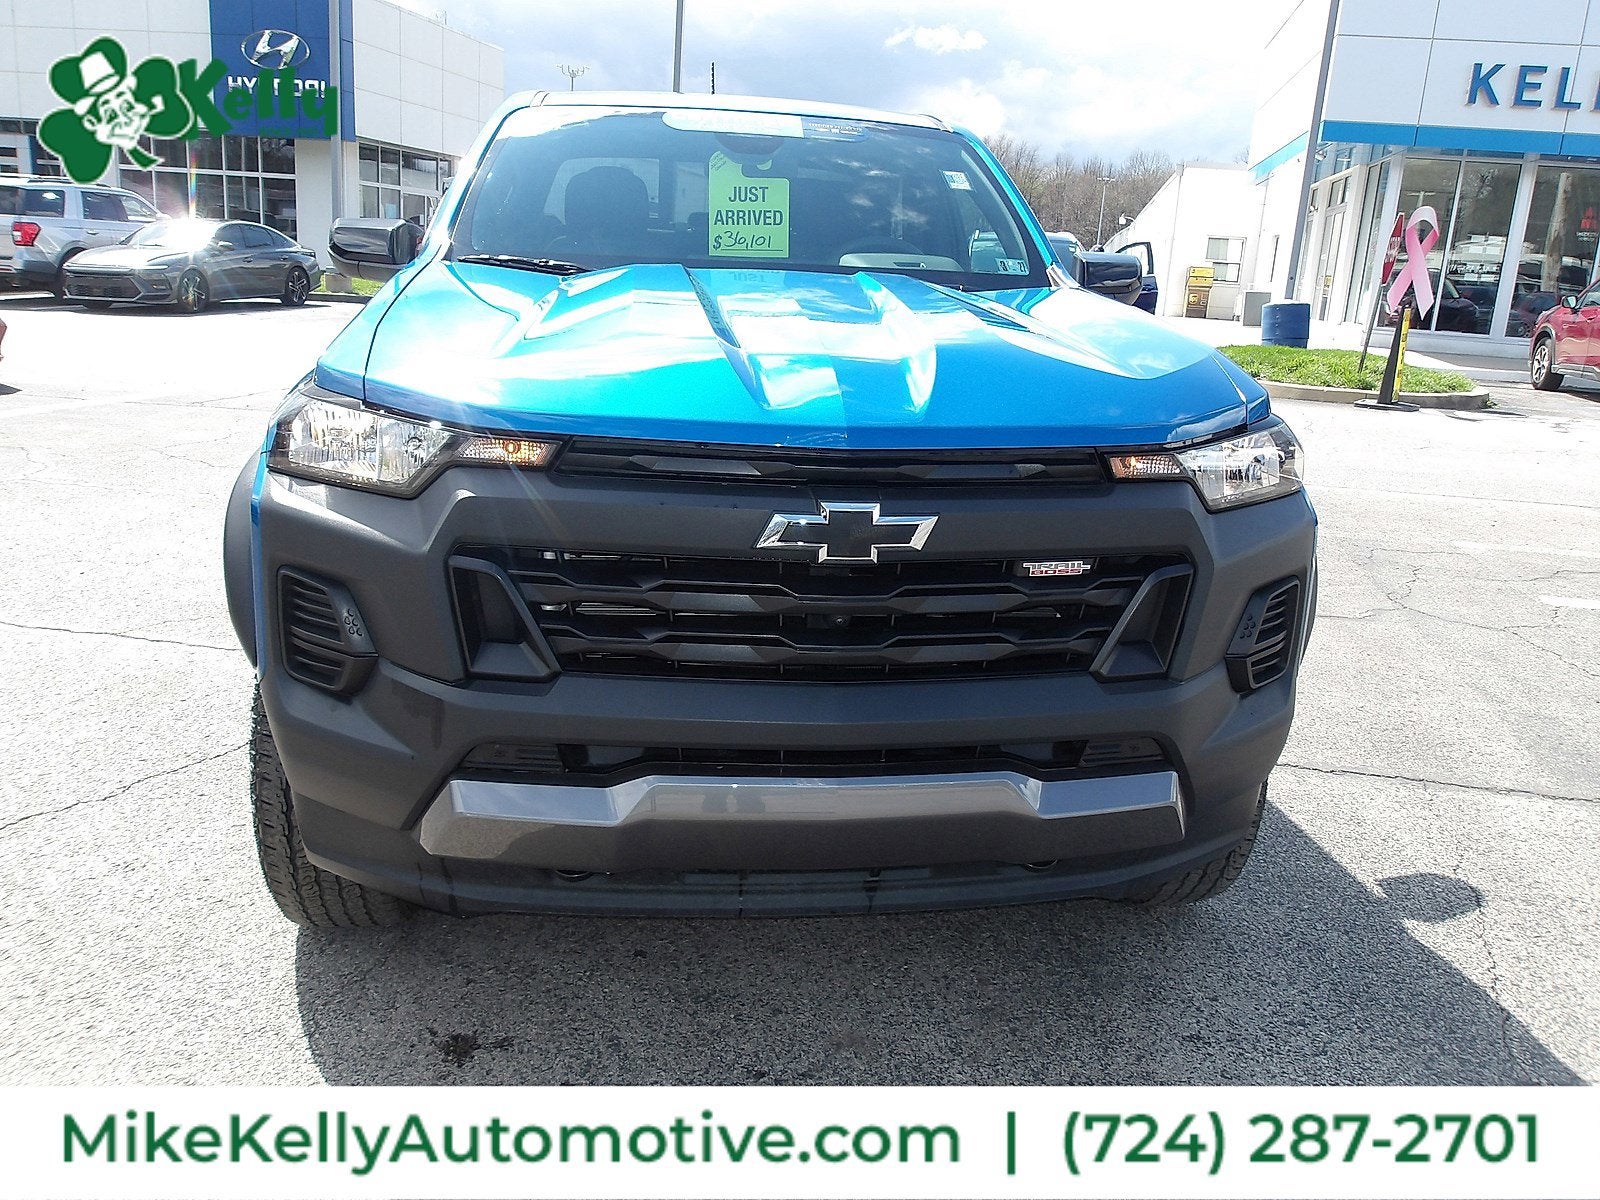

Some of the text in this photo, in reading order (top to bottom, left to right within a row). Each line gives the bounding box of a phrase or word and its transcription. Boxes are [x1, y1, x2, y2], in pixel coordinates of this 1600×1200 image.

[1465, 62, 1600, 111] KEL
[728, 186, 769, 203] JUST
[713, 209, 784, 226] ARRIVED
[1023, 561, 1091, 570] TRAIL
[1029, 568, 1083, 576] BOSS
